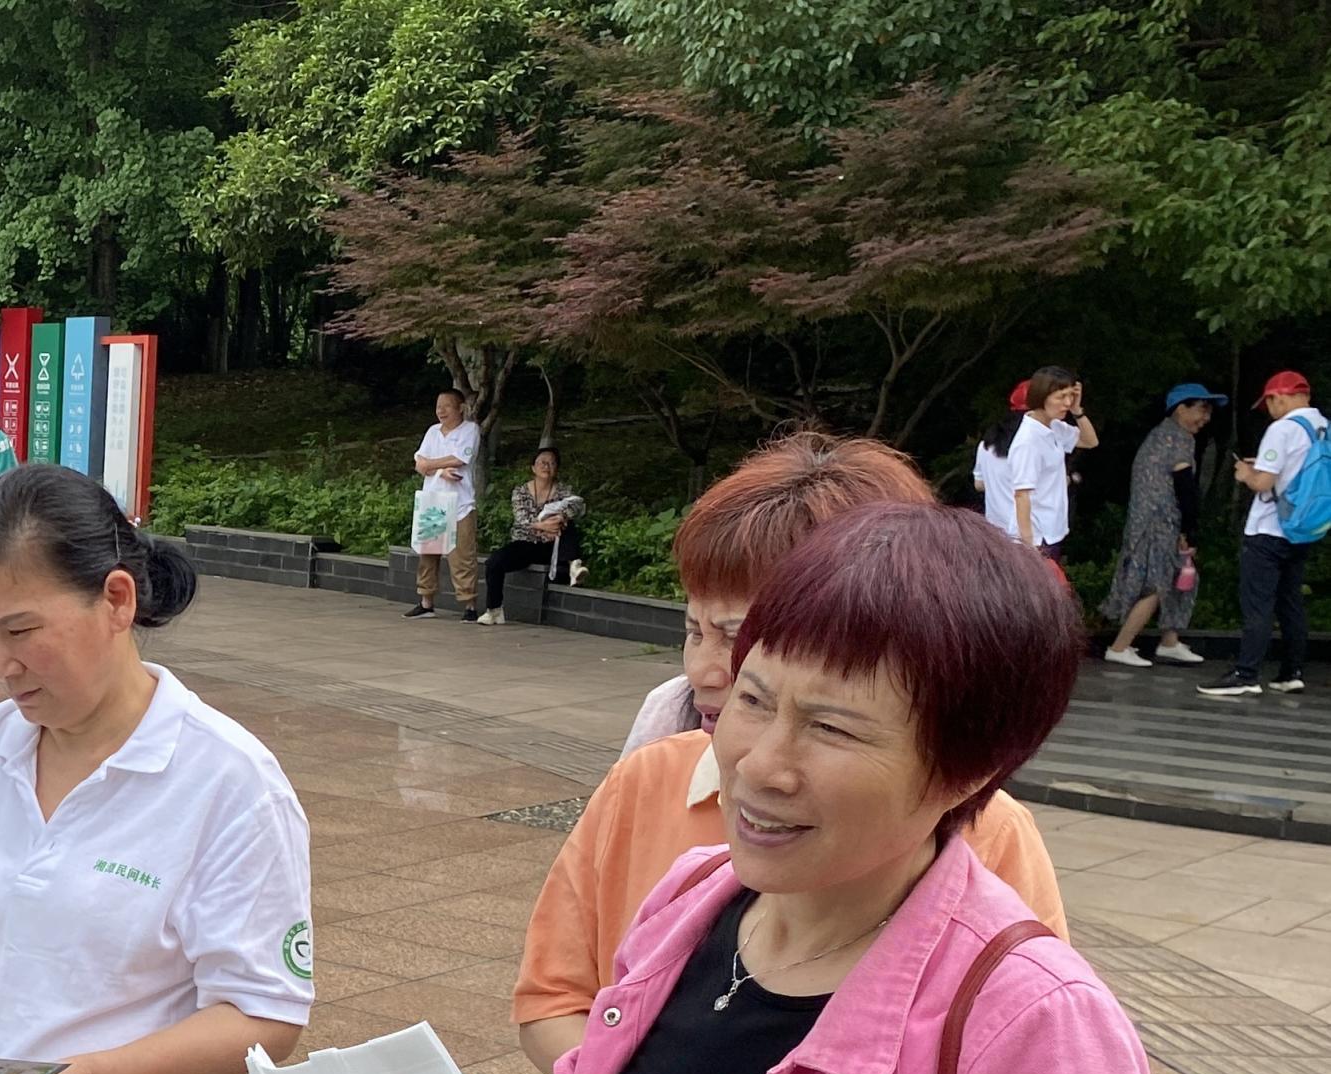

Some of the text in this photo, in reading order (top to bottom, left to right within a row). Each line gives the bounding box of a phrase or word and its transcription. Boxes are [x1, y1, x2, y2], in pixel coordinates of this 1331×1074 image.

[93, 857, 161, 890] 湘潭民间林长
